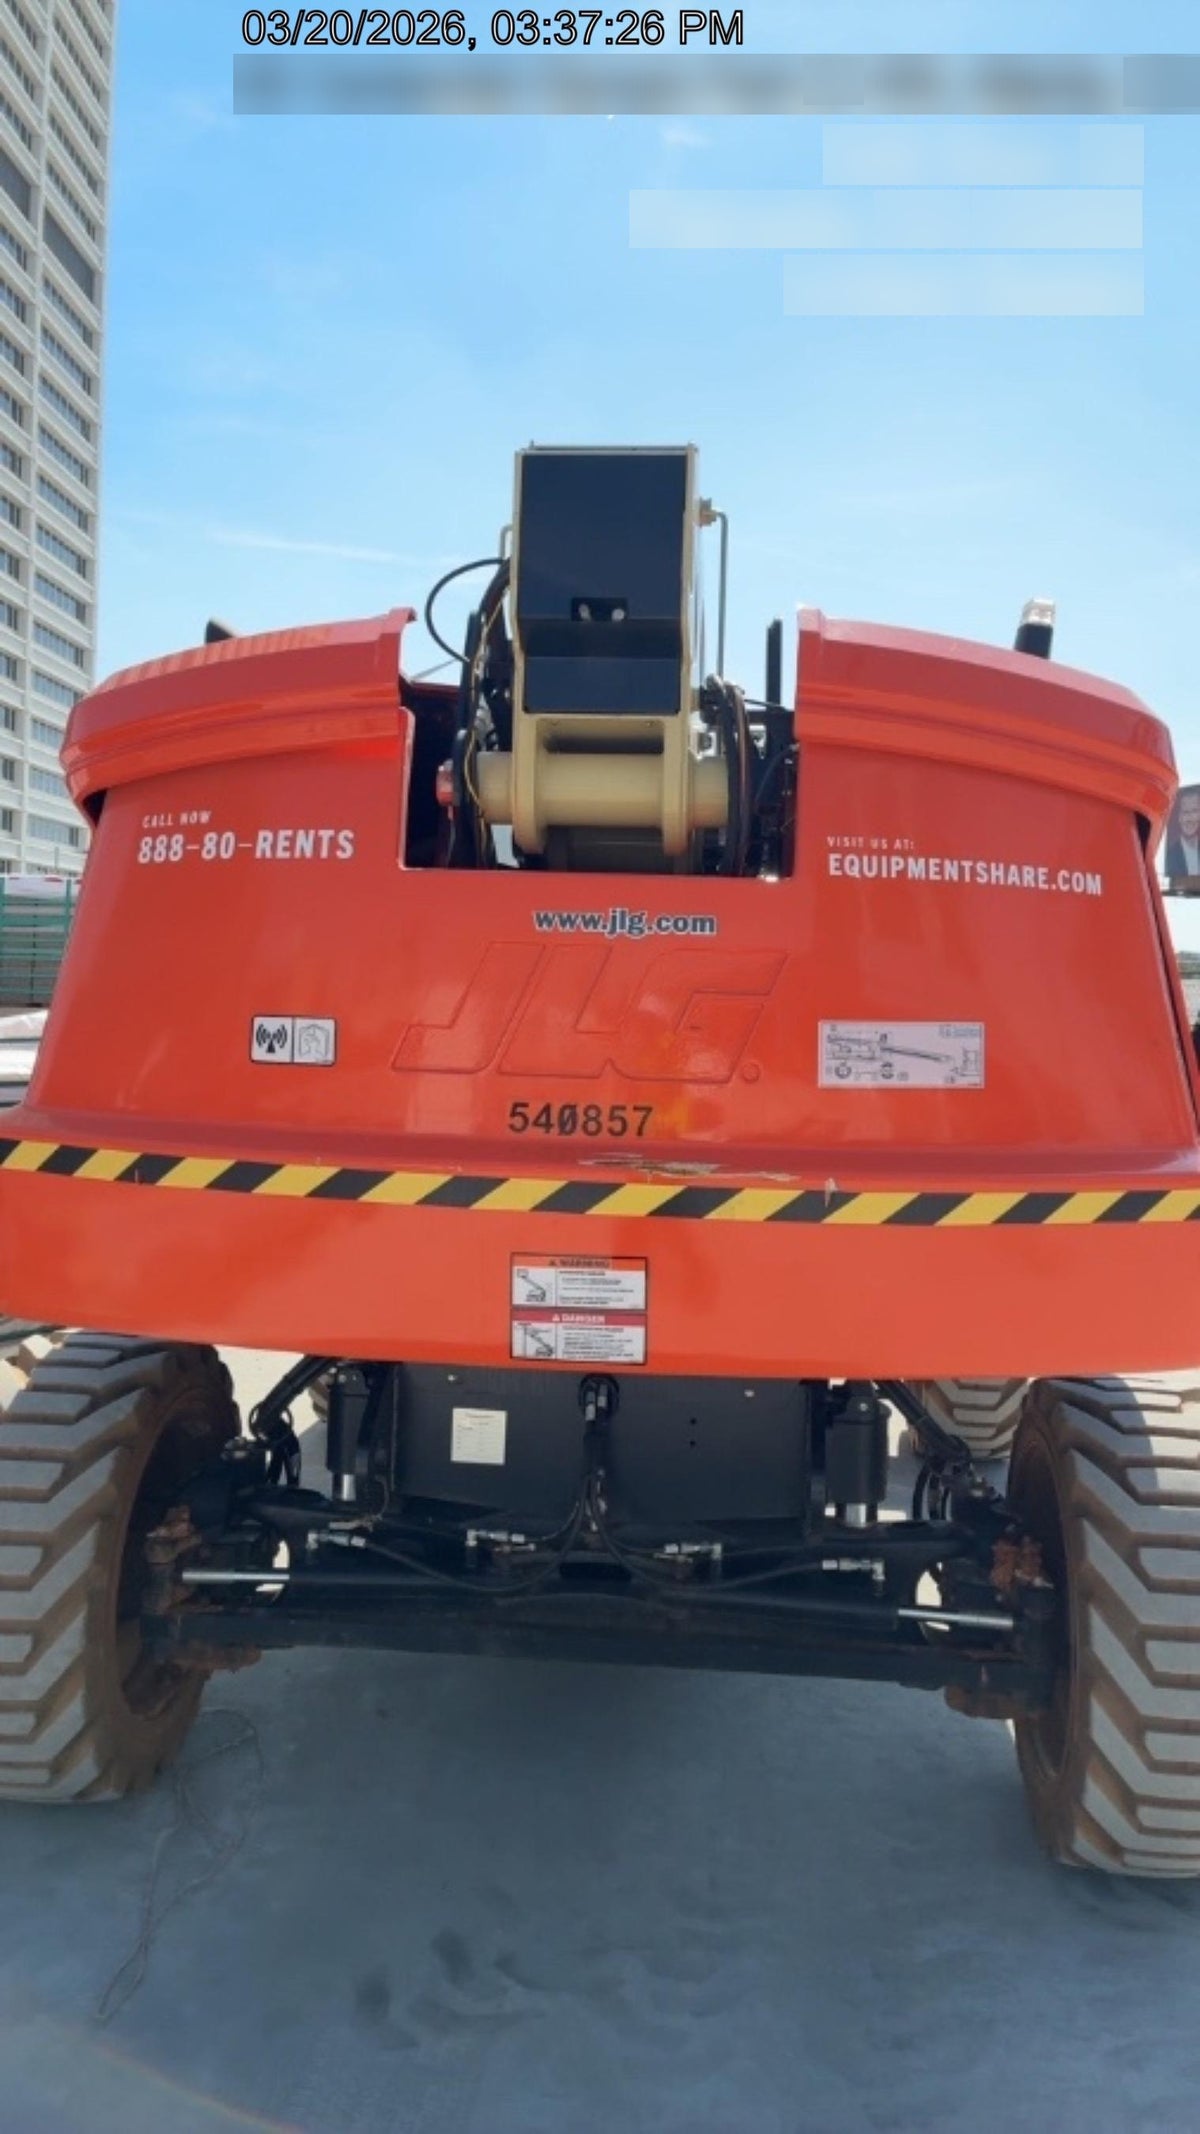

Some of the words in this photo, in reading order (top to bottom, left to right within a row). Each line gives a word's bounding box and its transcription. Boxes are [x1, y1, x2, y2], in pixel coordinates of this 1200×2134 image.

[142, 813, 174, 829] CALL
[180, 810, 212, 825] NOW
[137, 829, 354, 863] 888-80-RENTS
[827, 836, 864, 848] VISIT
[870, 838, 889, 850] US
[893, 839, 915, 851] AT:
[828, 854, 1102, 895] EQUIPMENTSHARE.COM
[534, 908, 716, 937] www.jlg.com
[508, 1102, 654, 1136] 540857
